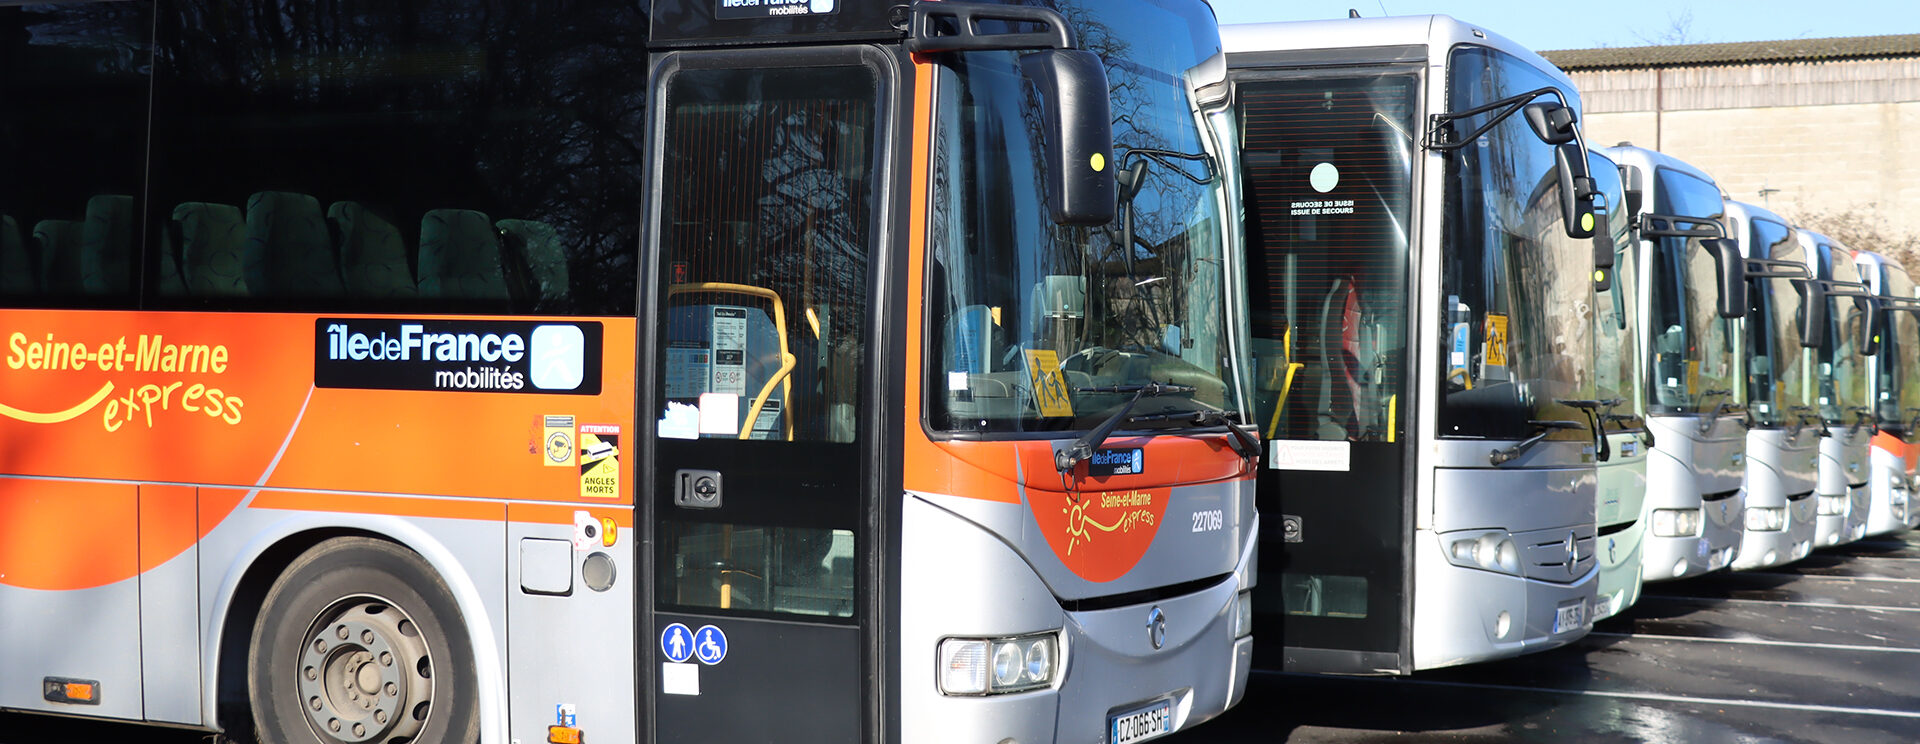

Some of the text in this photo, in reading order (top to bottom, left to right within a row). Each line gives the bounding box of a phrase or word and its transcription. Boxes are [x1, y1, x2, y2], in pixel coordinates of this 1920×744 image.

[769, 5, 808, 15] mobilités
[7, 332, 229, 374] Seine-et-Marne
[435, 366, 524, 390] mobilités
[103, 381, 244, 433] express
[580, 426, 619, 434] ATTENTION
[584, 477, 616, 486] ANGLES
[586, 486, 614, 494] MORTS
[1101, 490, 1152, 508] Seine-et-Marne
[1123, 509, 1155, 533] express
[1192, 509, 1223, 532] 227069
